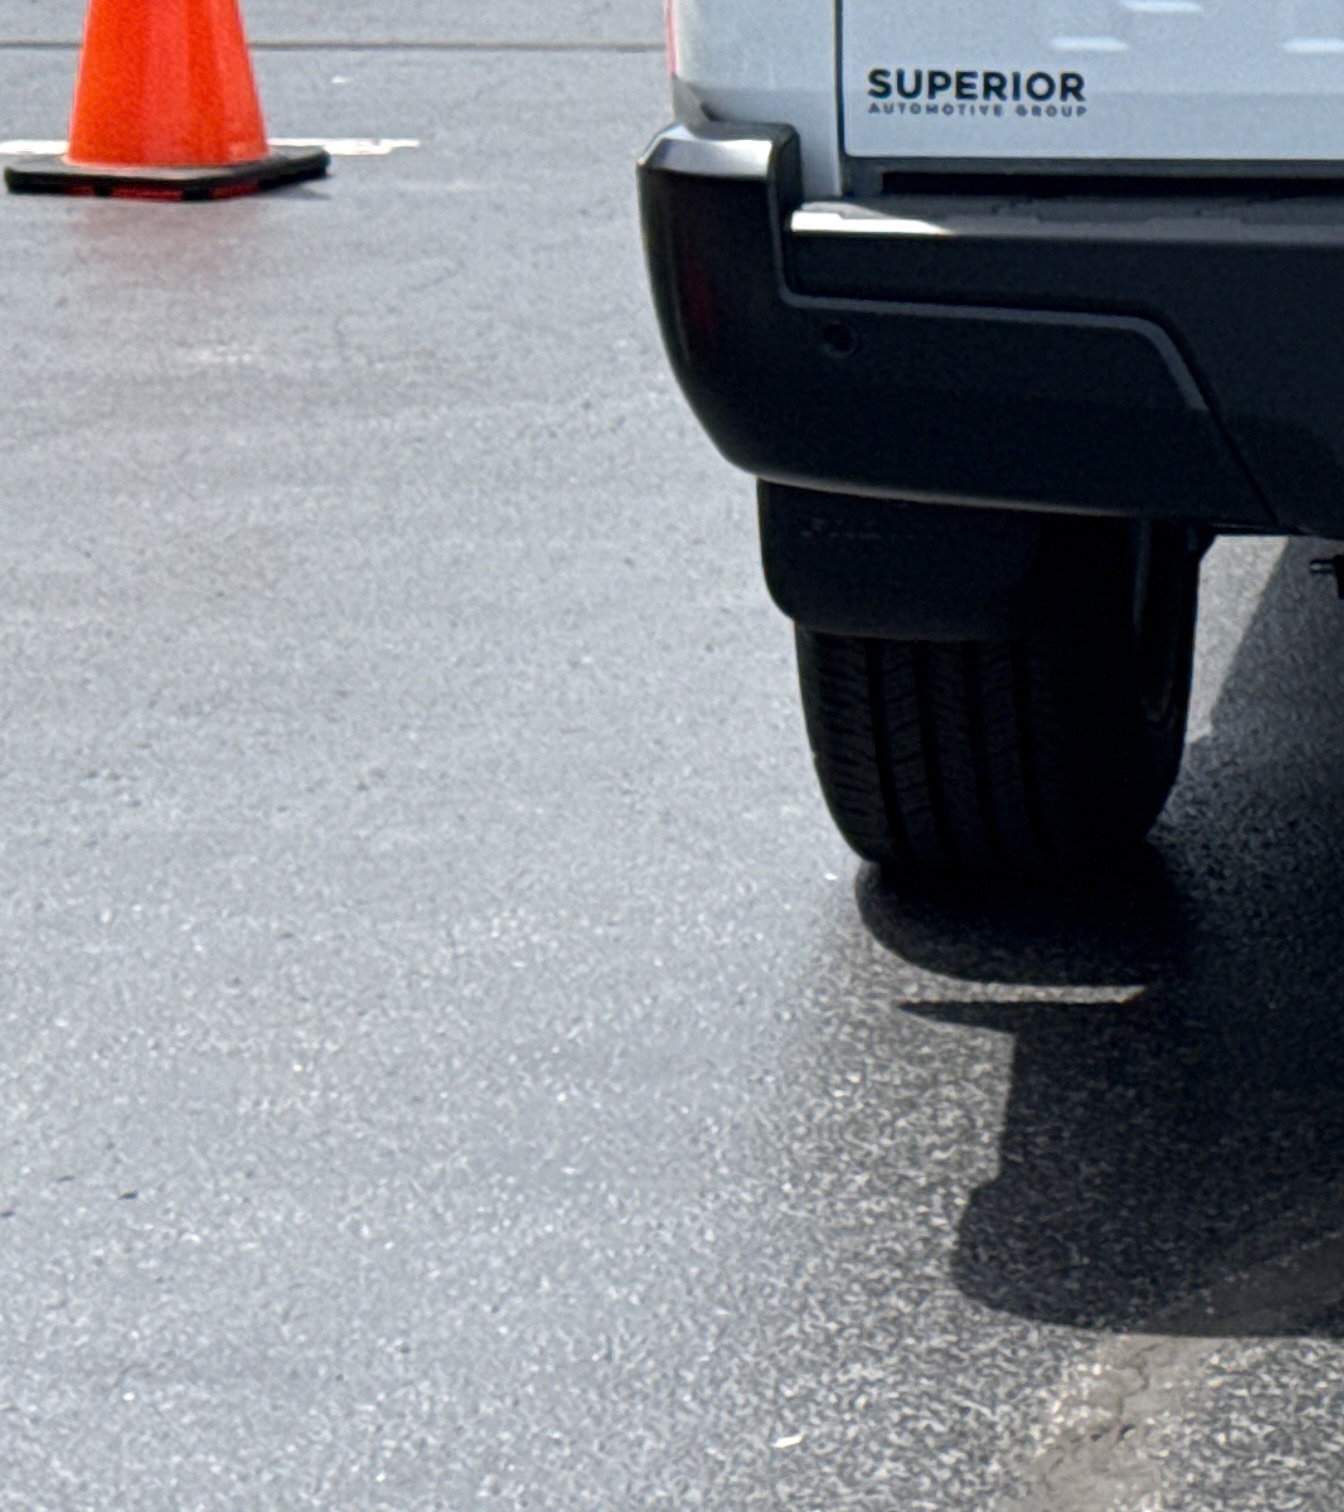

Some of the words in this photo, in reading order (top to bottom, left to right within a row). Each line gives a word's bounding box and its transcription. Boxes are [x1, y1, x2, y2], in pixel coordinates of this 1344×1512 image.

[868, 68, 1086, 101] SUPERIOR
[868, 102, 1004, 117] AUTOMOTIVE
[1015, 104, 1088, 118] GROUP
